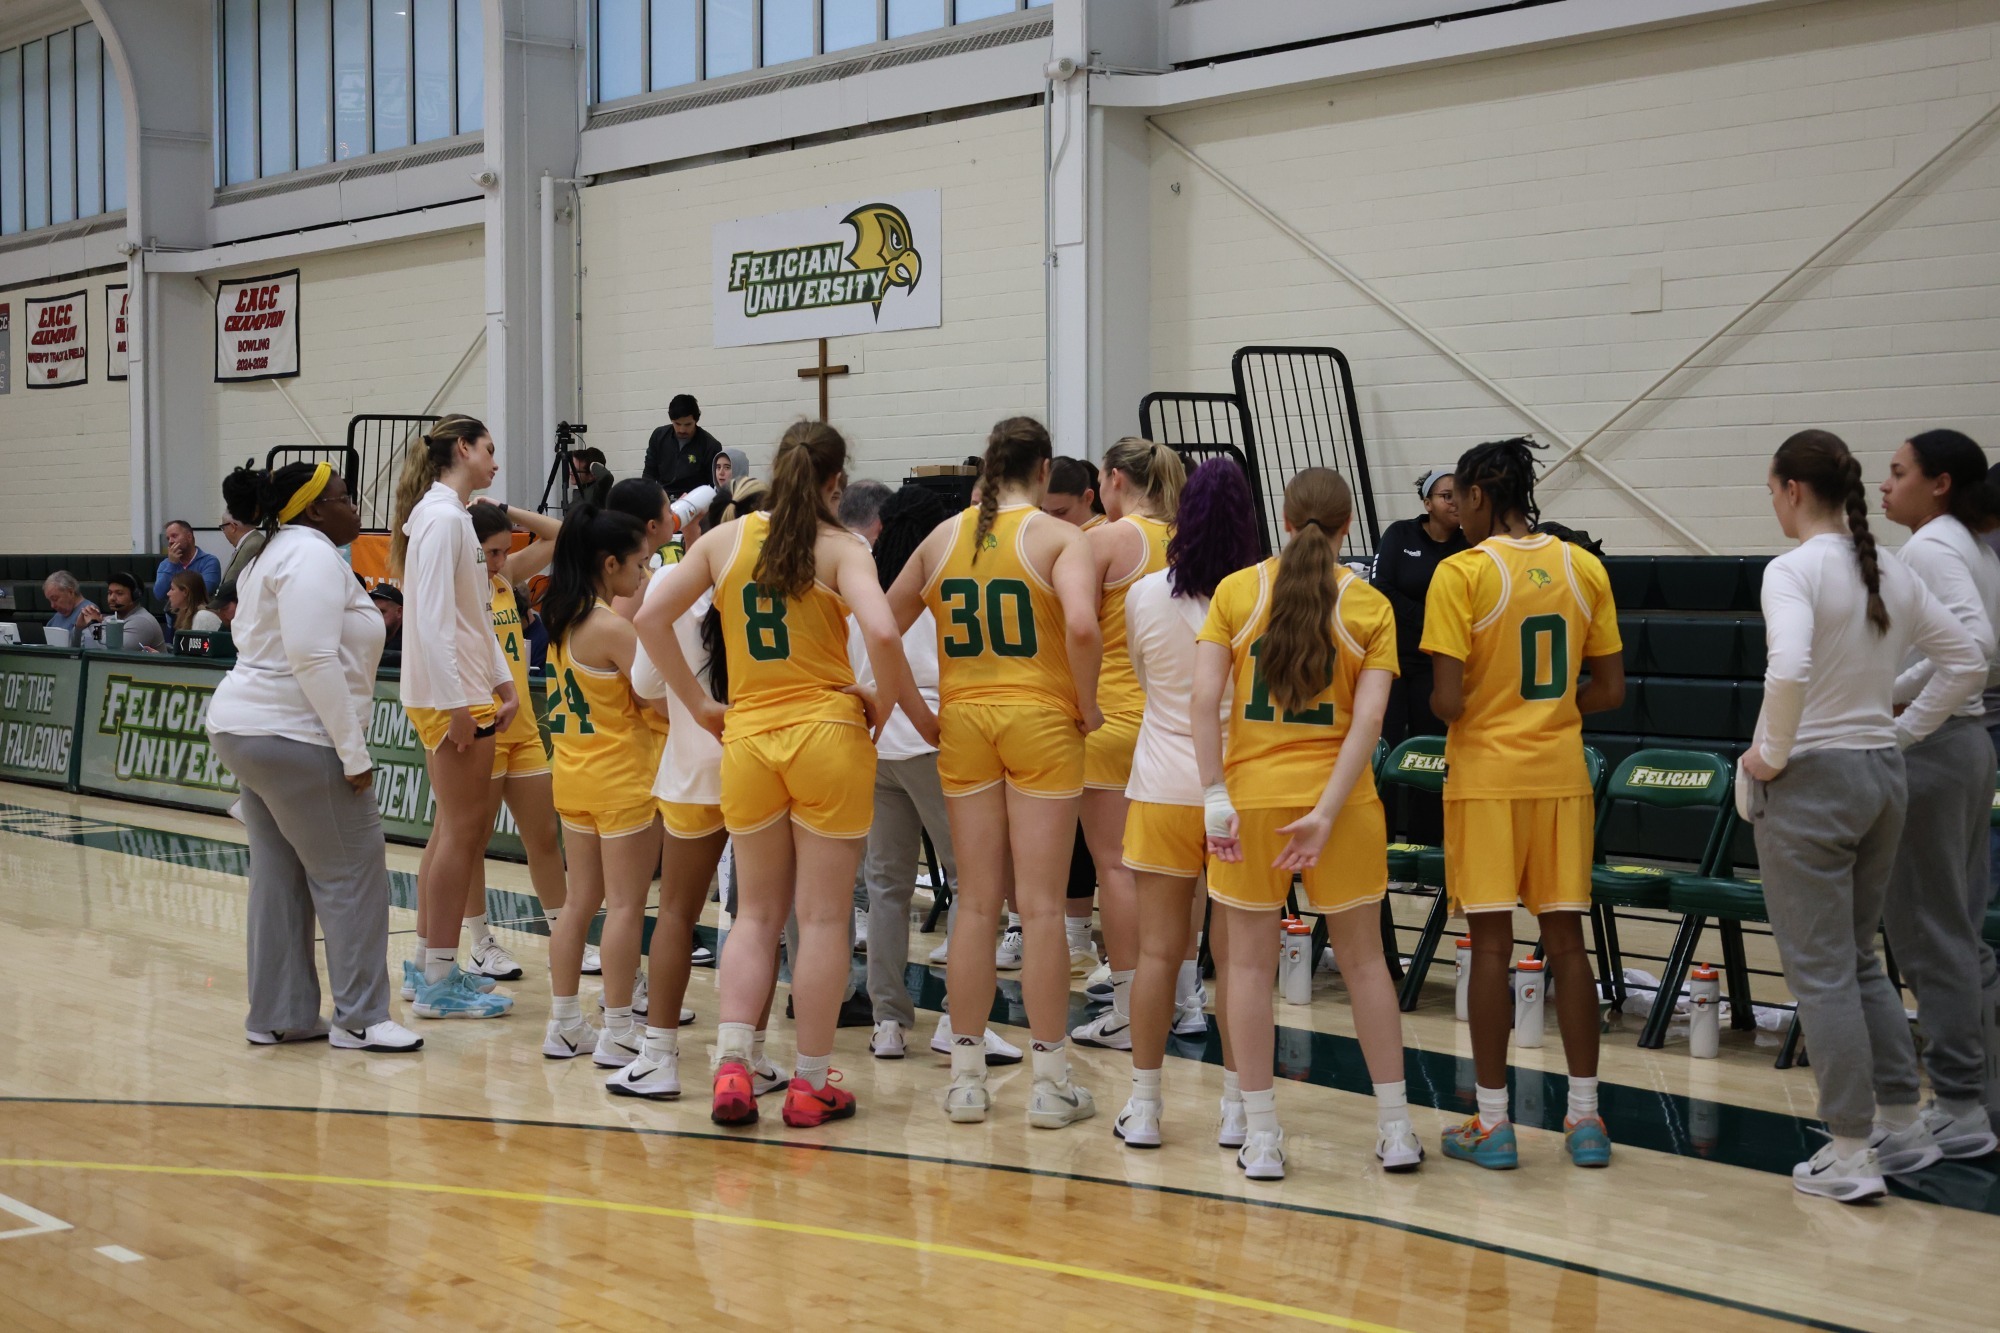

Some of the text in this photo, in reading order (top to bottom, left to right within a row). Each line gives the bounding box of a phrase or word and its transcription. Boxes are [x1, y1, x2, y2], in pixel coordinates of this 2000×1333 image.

[731, 245, 843, 289] FELICIAN
[235, 284, 280, 312] CACC
[745, 270, 887, 315] UNIVERSITY
[224, 310, 286, 332] CHAMPION
[237, 338, 270, 352] BOWLING
[741, 582, 792, 662] 8
[939, 577, 1039, 659] 30
[1520, 613, 1569, 701] 0
[4, 673, 25, 710] OF
[26, 675, 56, 713] THE
[545, 662, 596, 734] 24
[3, 722, 73, 773] FALCONS
[1629, 768, 1713, 787] FELICIAN
